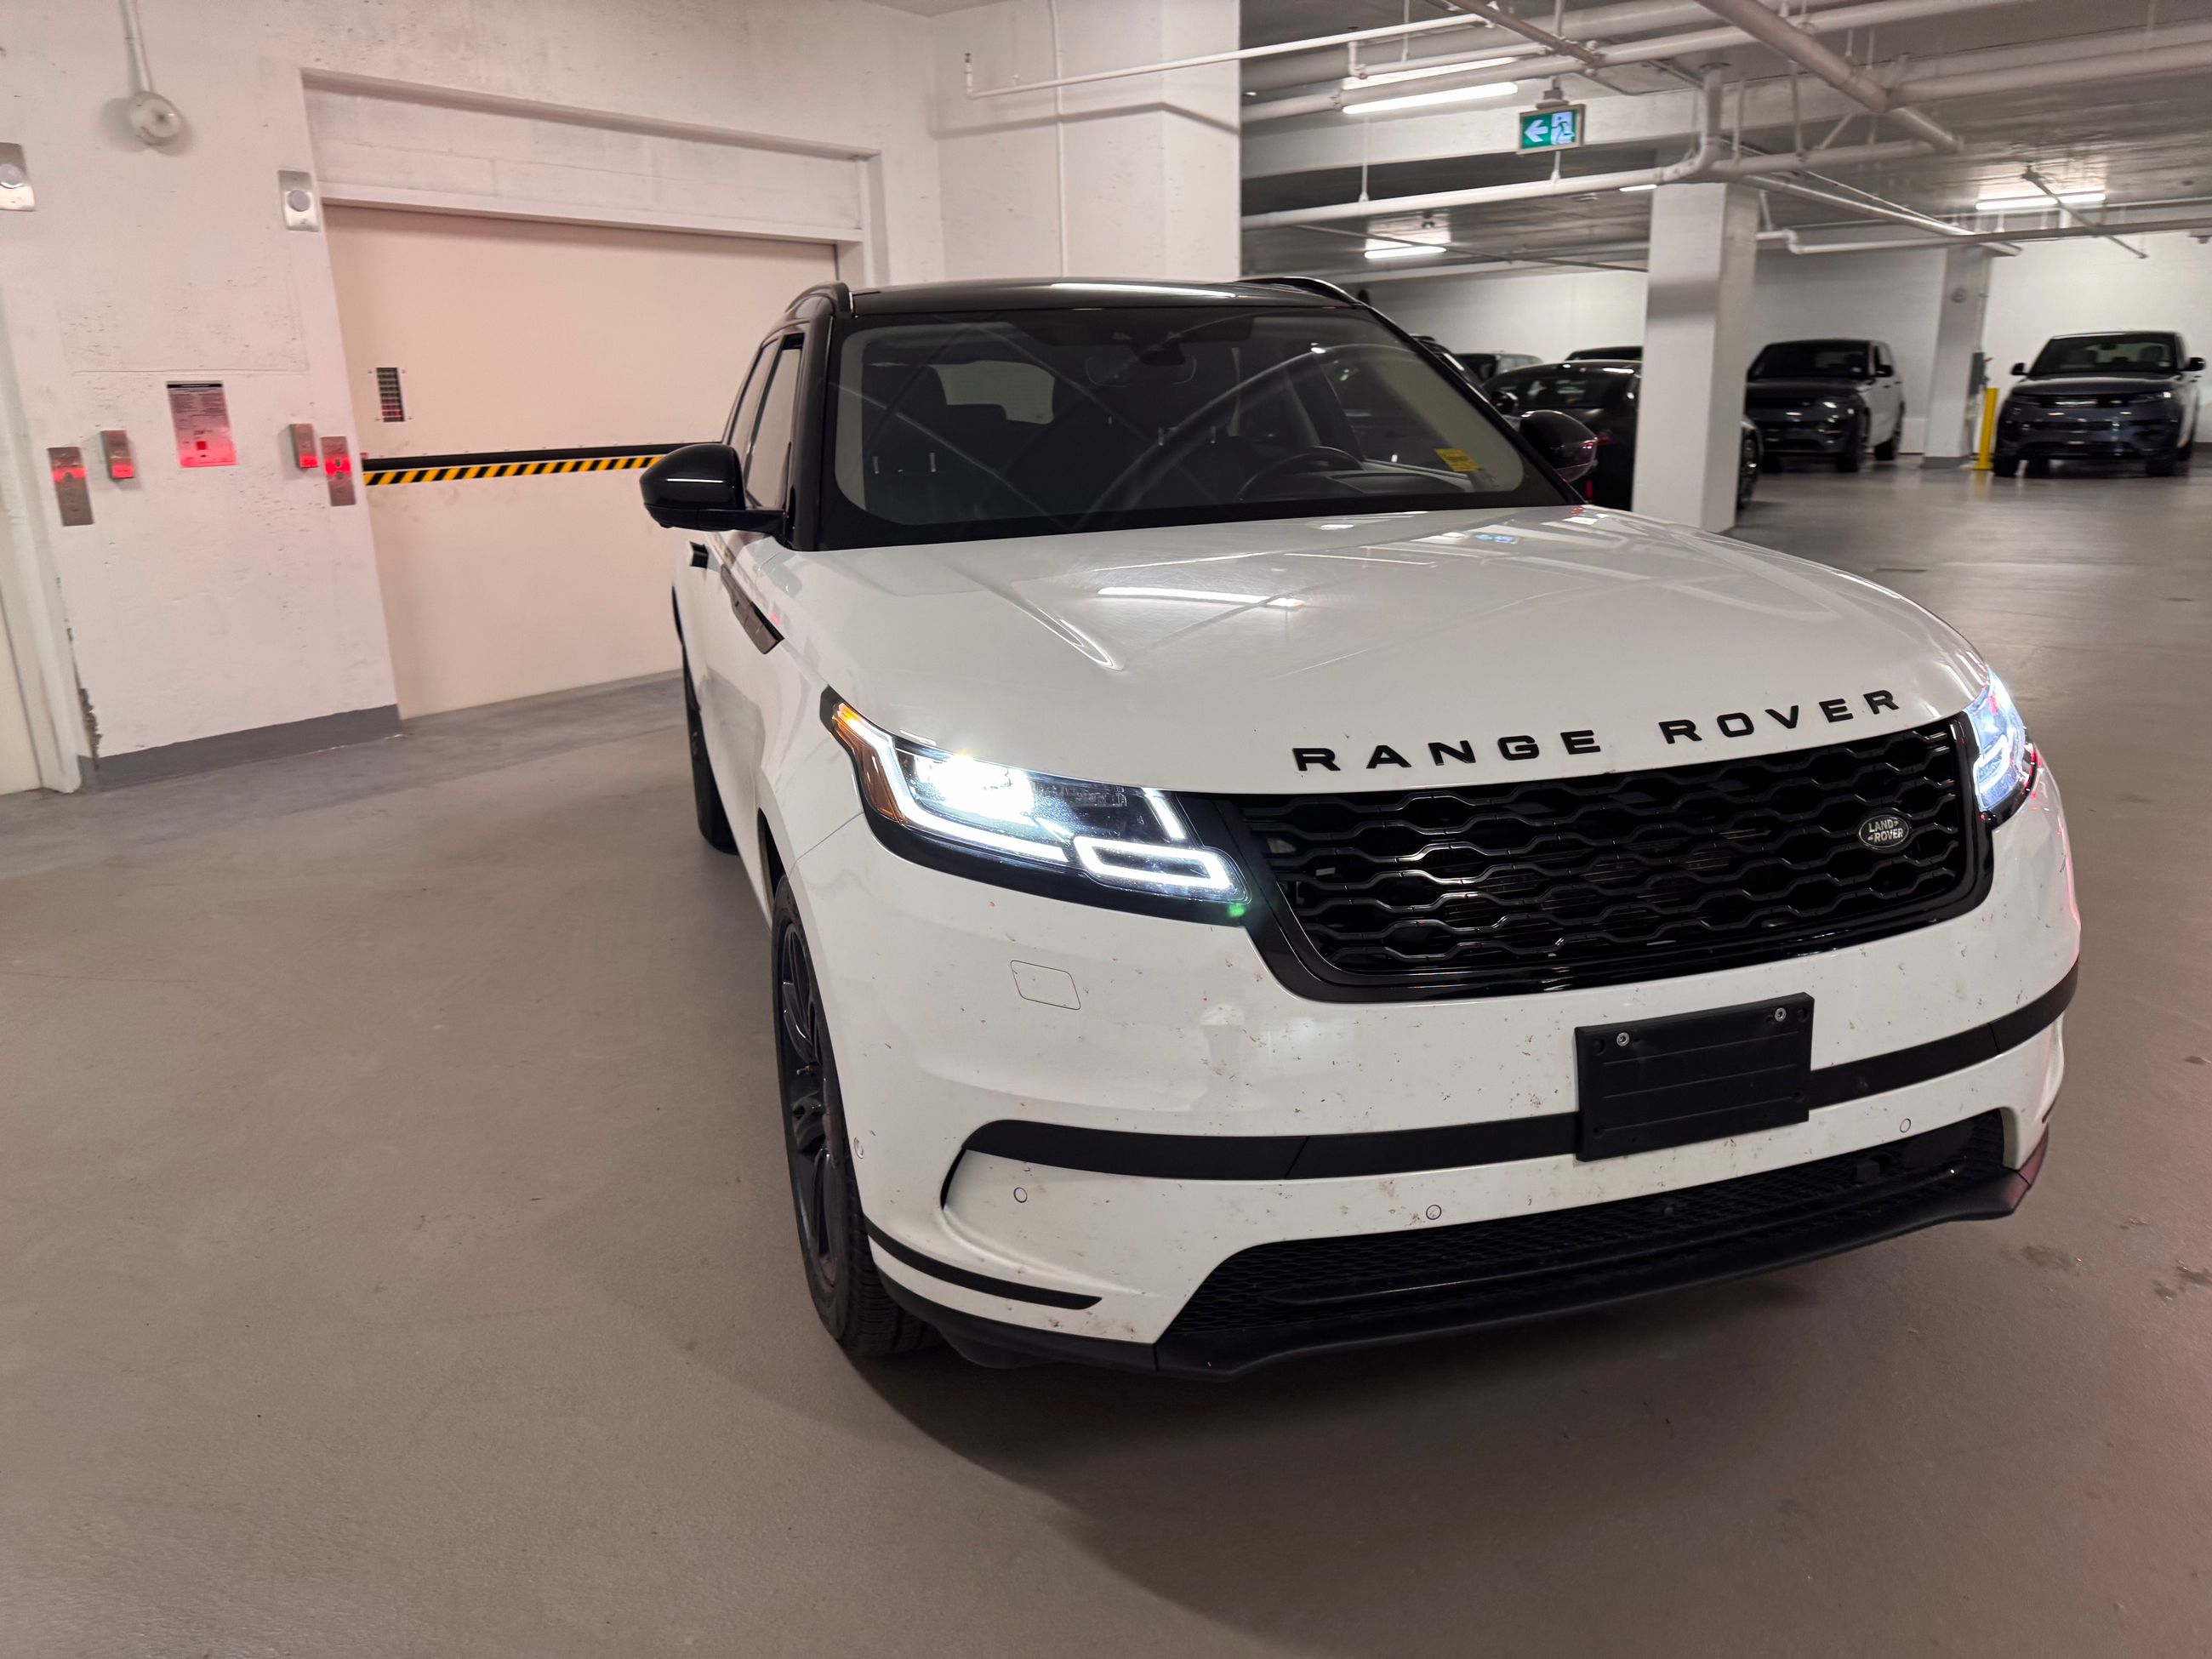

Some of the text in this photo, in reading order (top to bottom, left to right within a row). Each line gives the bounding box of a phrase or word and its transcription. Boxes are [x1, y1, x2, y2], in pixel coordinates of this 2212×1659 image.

[1291, 689, 1899, 772] RANGE ROVER
[1868, 819, 1894, 833] LAND
[1874, 828, 1903, 842] ROVER
